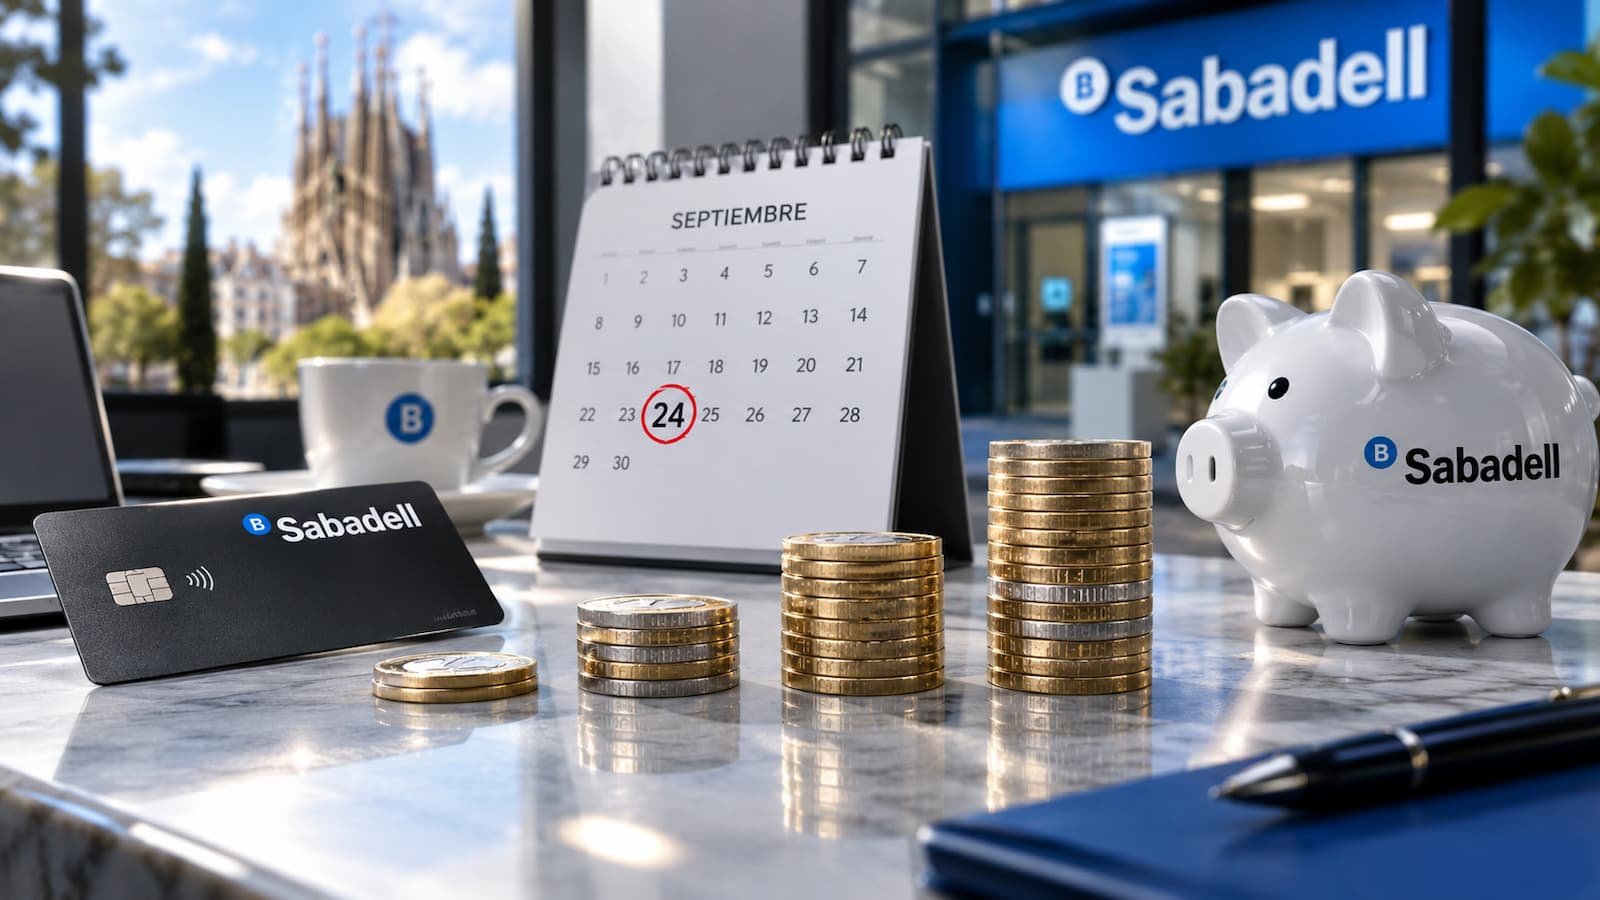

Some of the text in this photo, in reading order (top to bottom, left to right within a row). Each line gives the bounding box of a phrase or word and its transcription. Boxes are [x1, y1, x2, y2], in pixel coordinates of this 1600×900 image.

[1076, 24, 1428, 135] B Sabadell
[670, 201, 808, 230] SEPTIEMBRE
[603, 258, 868, 286] 1 2 3 4 5 6 7
[594, 306, 868, 331] 8 9 10 11 12 13 14
[587, 356, 864, 376] 15 16 17 18 19 20 21
[401, 404, 423, 432] B
[578, 402, 861, 428] 22 23 24 25 26 27 28
[572, 454, 631, 471] 29 30
[1374, 442, 1561, 486] B Sabadell
[249, 502, 423, 543] B Sabadell
